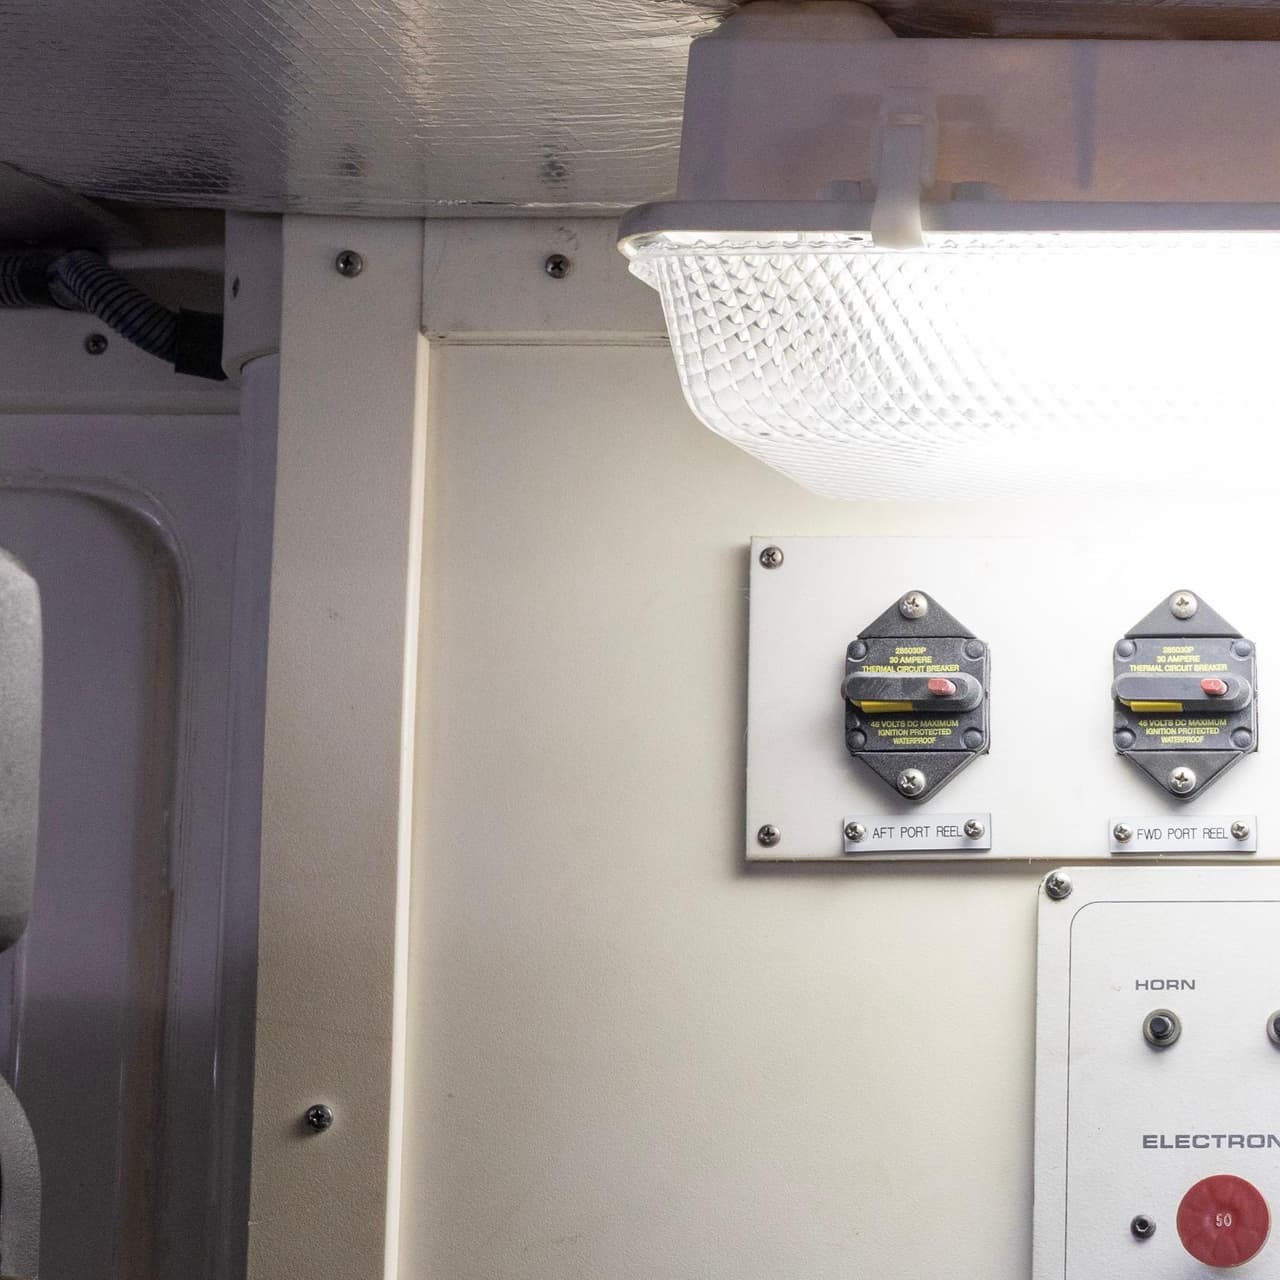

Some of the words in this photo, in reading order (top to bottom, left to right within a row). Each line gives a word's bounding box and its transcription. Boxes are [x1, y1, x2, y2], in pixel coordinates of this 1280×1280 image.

[900, 656, 933, 664] AMPERE
[1166, 655, 1200, 663] AMPERE
[862, 664, 896, 672] THERMAL
[896, 664, 926, 672] CIRCUIT
[926, 664, 960, 672] BREAKER
[1130, 664, 1162, 672] THERMAL
[1164, 664, 1193, 672] CIRCUIT
[1194, 664, 1228, 672] BREAKER
[878, 728, 910, 736] IGNITION
[910, 728, 952, 736] PROTECTED
[1146, 728, 1176, 736] IGNITION
[1177, 728, 1220, 736] PROTECTED
[893, 736, 936, 744] WATERPROOF
[1161, 736, 1204, 744] WATERPROOF
[872, 827, 894, 840] AFT
[899, 826, 931, 838] PORT
[935, 825, 963, 838] REEL
[1137, 828, 1162, 840] FWD
[1167, 828, 1197, 840] PORT
[1202, 828, 1229, 840] REEL
[1135, 979, 1196, 991] HORN
[1216, 1212, 1233, 1229] 50
